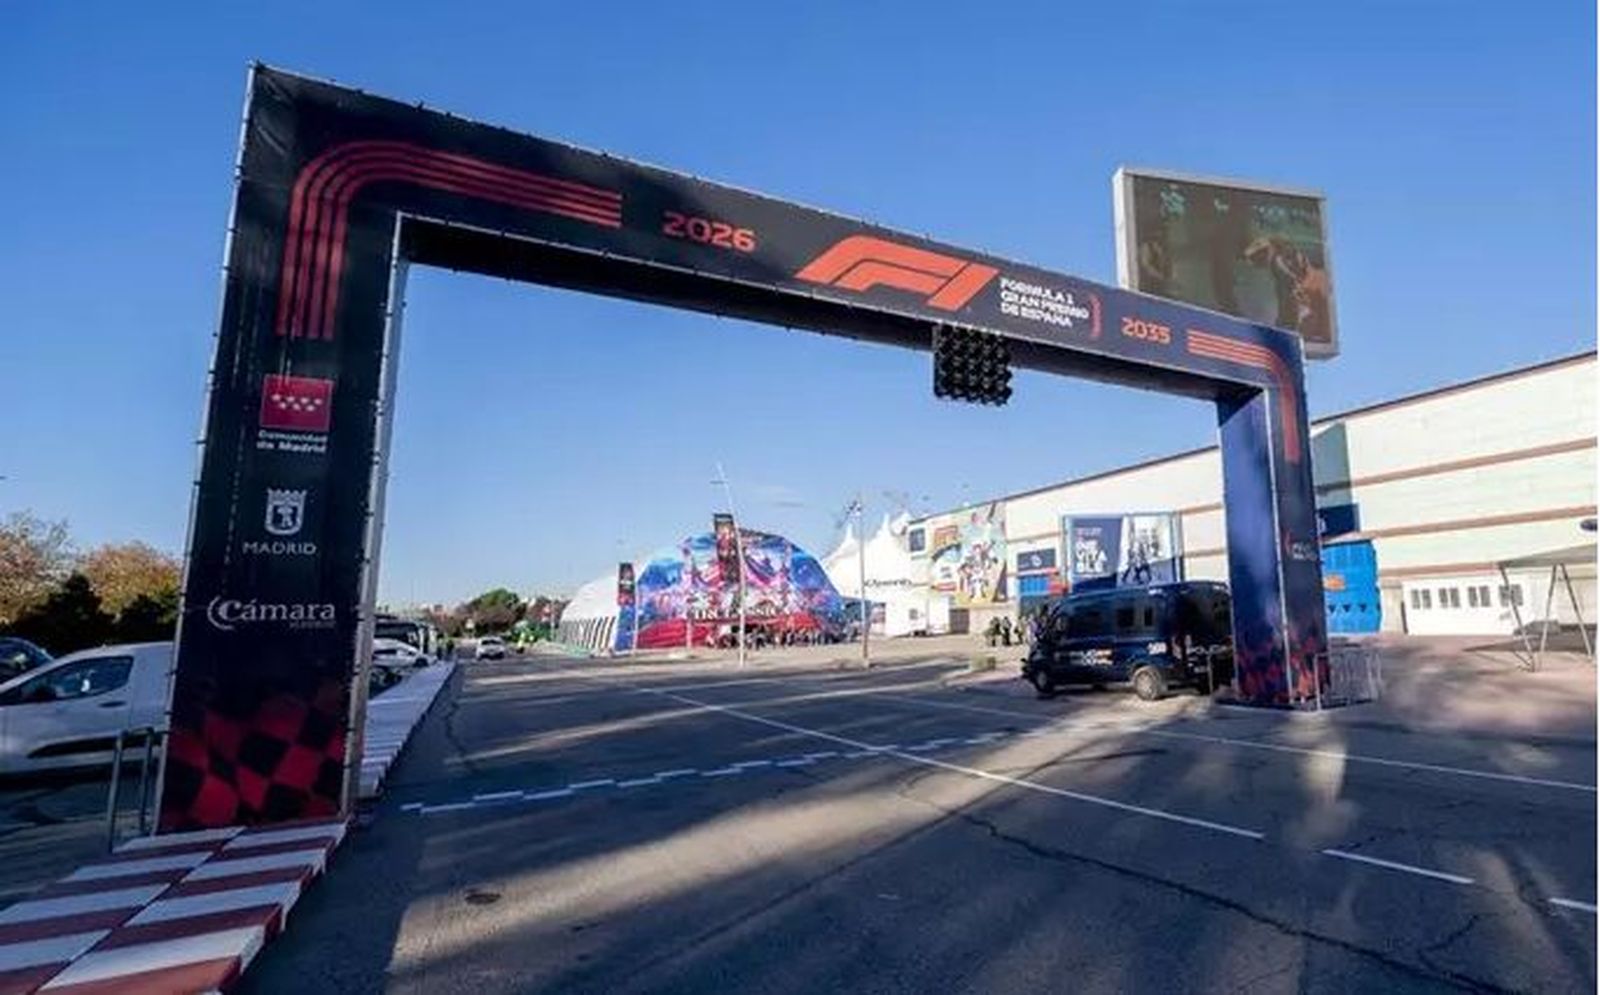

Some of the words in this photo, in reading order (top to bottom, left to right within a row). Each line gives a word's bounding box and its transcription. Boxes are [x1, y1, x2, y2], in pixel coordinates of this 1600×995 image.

[662, 211, 756, 252] 2026
[1000, 277, 1066, 302] FORMULA
[1066, 292, 1075, 306] 1
[1000, 289, 1040, 307] GRAN
[1040, 299, 1090, 320] PREMIO
[1000, 301, 1020, 317] DE
[1121, 316, 1171, 345] 2035
[277, 440, 327, 453] Madrid
[242, 541, 318, 555] MADRID
[217, 598, 336, 621] Cámara
